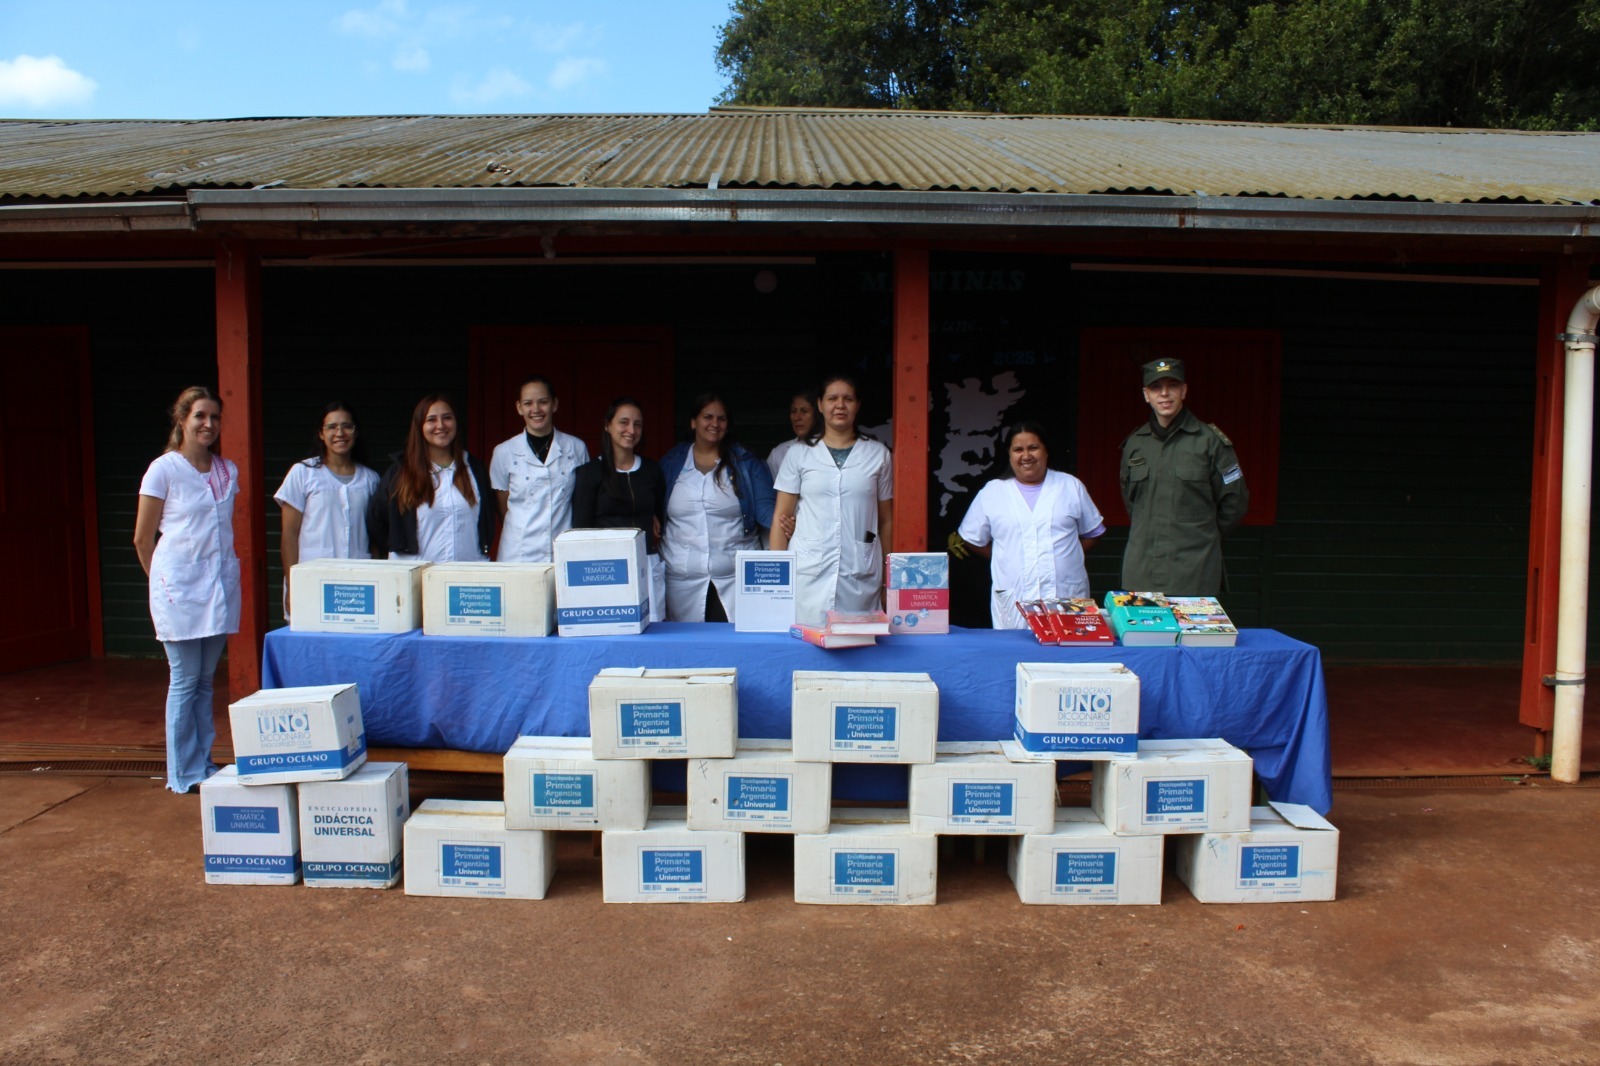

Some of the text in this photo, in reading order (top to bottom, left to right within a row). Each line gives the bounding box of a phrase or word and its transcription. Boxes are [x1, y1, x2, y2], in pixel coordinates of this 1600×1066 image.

[993, 351, 1035, 366] 2025
[584, 566, 616, 574] TEMÁTICA
[597, 608, 635, 616] OCEANO
[1059, 694, 1112, 712] UNO
[848, 714, 883, 722] Primaria
[1058, 712, 1110, 720] DICCIONARIO
[258, 714, 309, 733] UNO
[260, 732, 311, 742] DICCIONARIO
[1043, 736, 1124, 744] GRUPO OCEANO
[250, 754, 328, 766] GRUPO OCEANO
[232, 812, 265, 820] TEMÁTICA
[314, 813, 374, 824] DIDÁCTICA
[314, 827, 375, 837] UNIVERSAL
[455, 852, 489, 860] Primaria
[246, 857, 286, 865] OCEANO
[308, 864, 385, 872] GRUPO OCEANO
